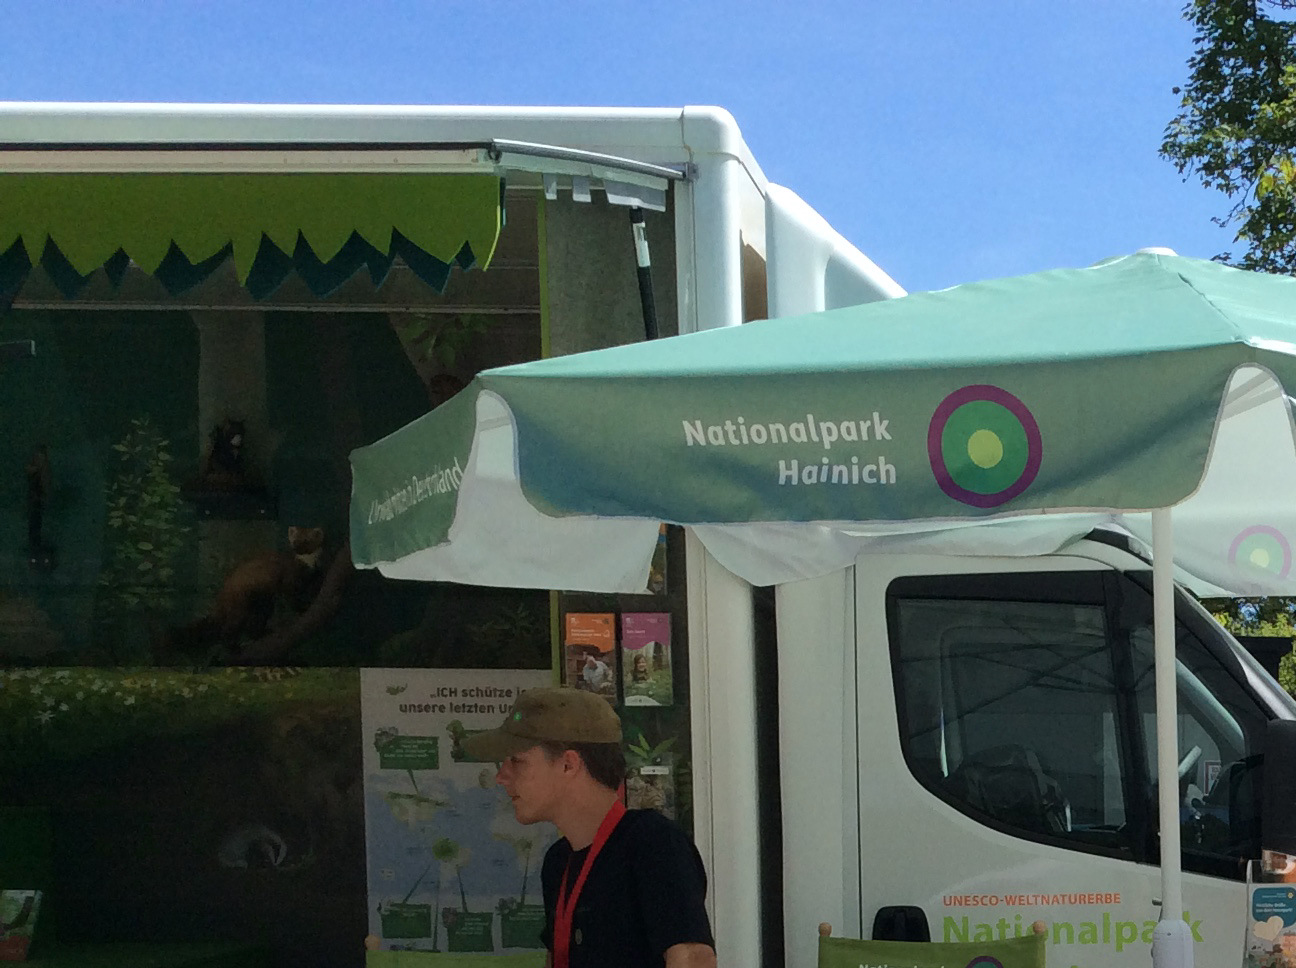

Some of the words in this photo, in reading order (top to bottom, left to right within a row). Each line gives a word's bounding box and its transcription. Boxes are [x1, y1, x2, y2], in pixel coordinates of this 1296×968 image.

[682, 412, 893, 450] Nationalpark
[778, 456, 897, 486] Hainich
[461, 686, 513, 698] schütze
[399, 702, 446, 713] unsere
[449, 702, 495, 713] letzten
[942, 893, 1121, 906] UNESCO-WELTNATURERBE
[943, 911, 1205, 952] Natinalpak
